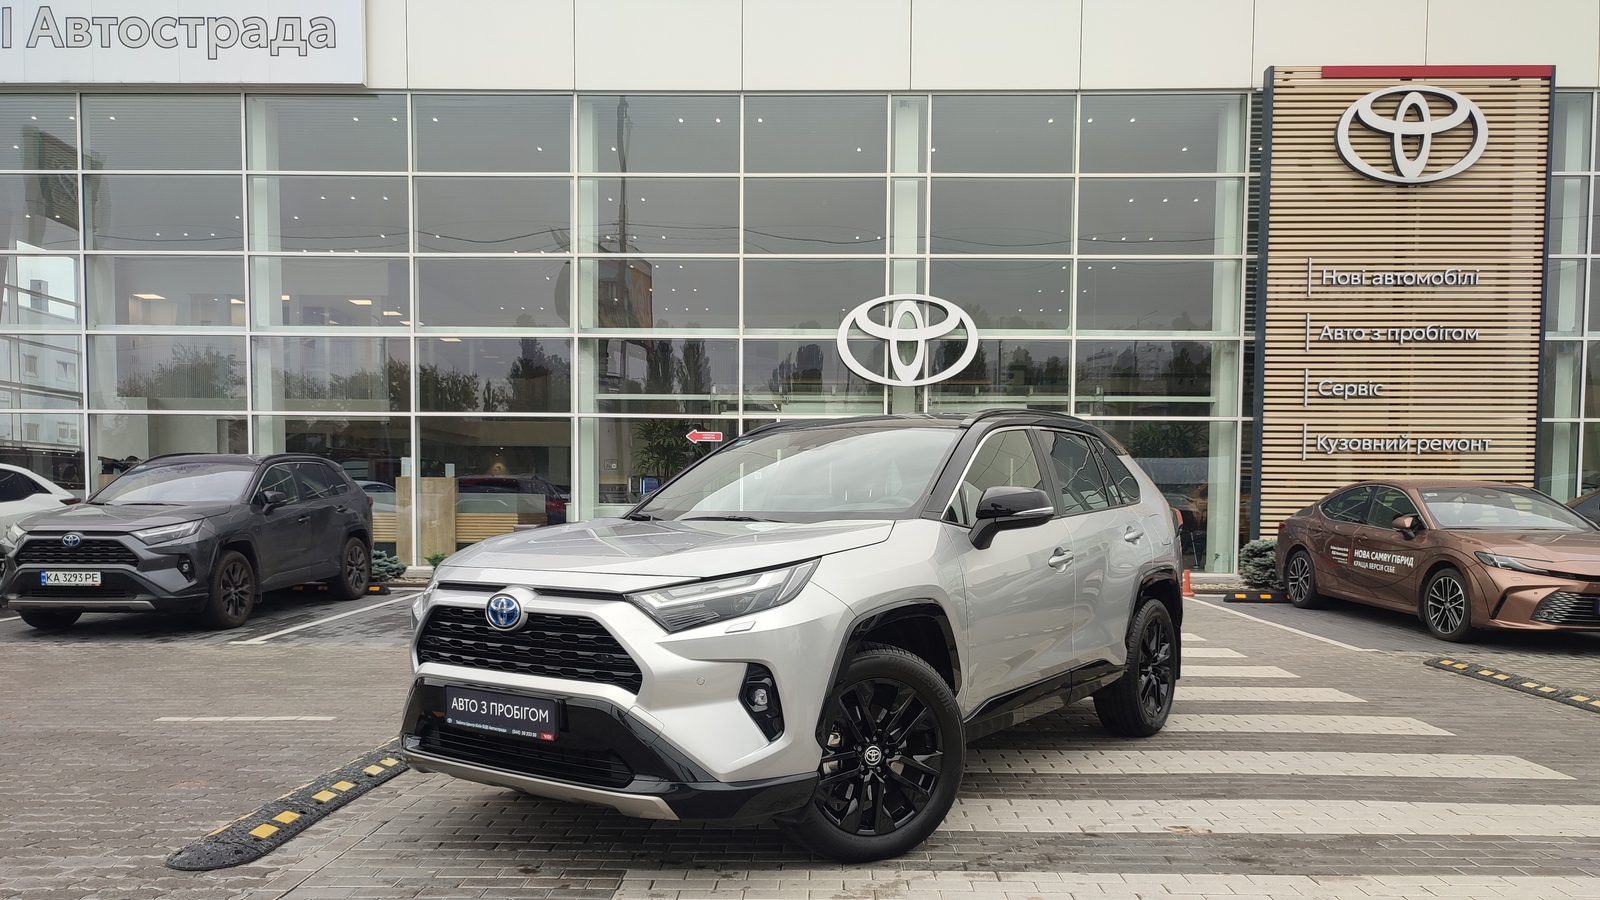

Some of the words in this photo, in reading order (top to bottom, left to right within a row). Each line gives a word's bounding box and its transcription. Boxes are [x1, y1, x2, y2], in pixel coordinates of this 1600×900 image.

[26, 5, 337, 60] Автострада
[1321, 269, 1366, 286] Нові
[1372, 269, 1480, 286] автомобілі
[1318, 324, 1366, 342] Авто
[1371, 329, 1382, 342] з
[1387, 324, 1480, 345] пробігом
[1317, 380, 1385, 400] Сервіс
[1315, 433, 1412, 455] Кузовний
[1416, 437, 1492, 455] ремонт
[1353, 560, 1368, 569] КРАЩА
[1383, 565, 1396, 573] СЕБЕ
[1354, 549, 1370, 559] НОВА
[1370, 551, 1391, 563] CAMRY
[1391, 554, 1414, 568] ГІБРИД
[47, 573, 60, 582] KA
[62, 573, 83, 582] 3293
[85, 573, 98, 582] PE
[451, 697, 478, 713] АВТО
[480, 701, 488, 714] З
[489, 702, 549, 723] ПРОБІГОМ
